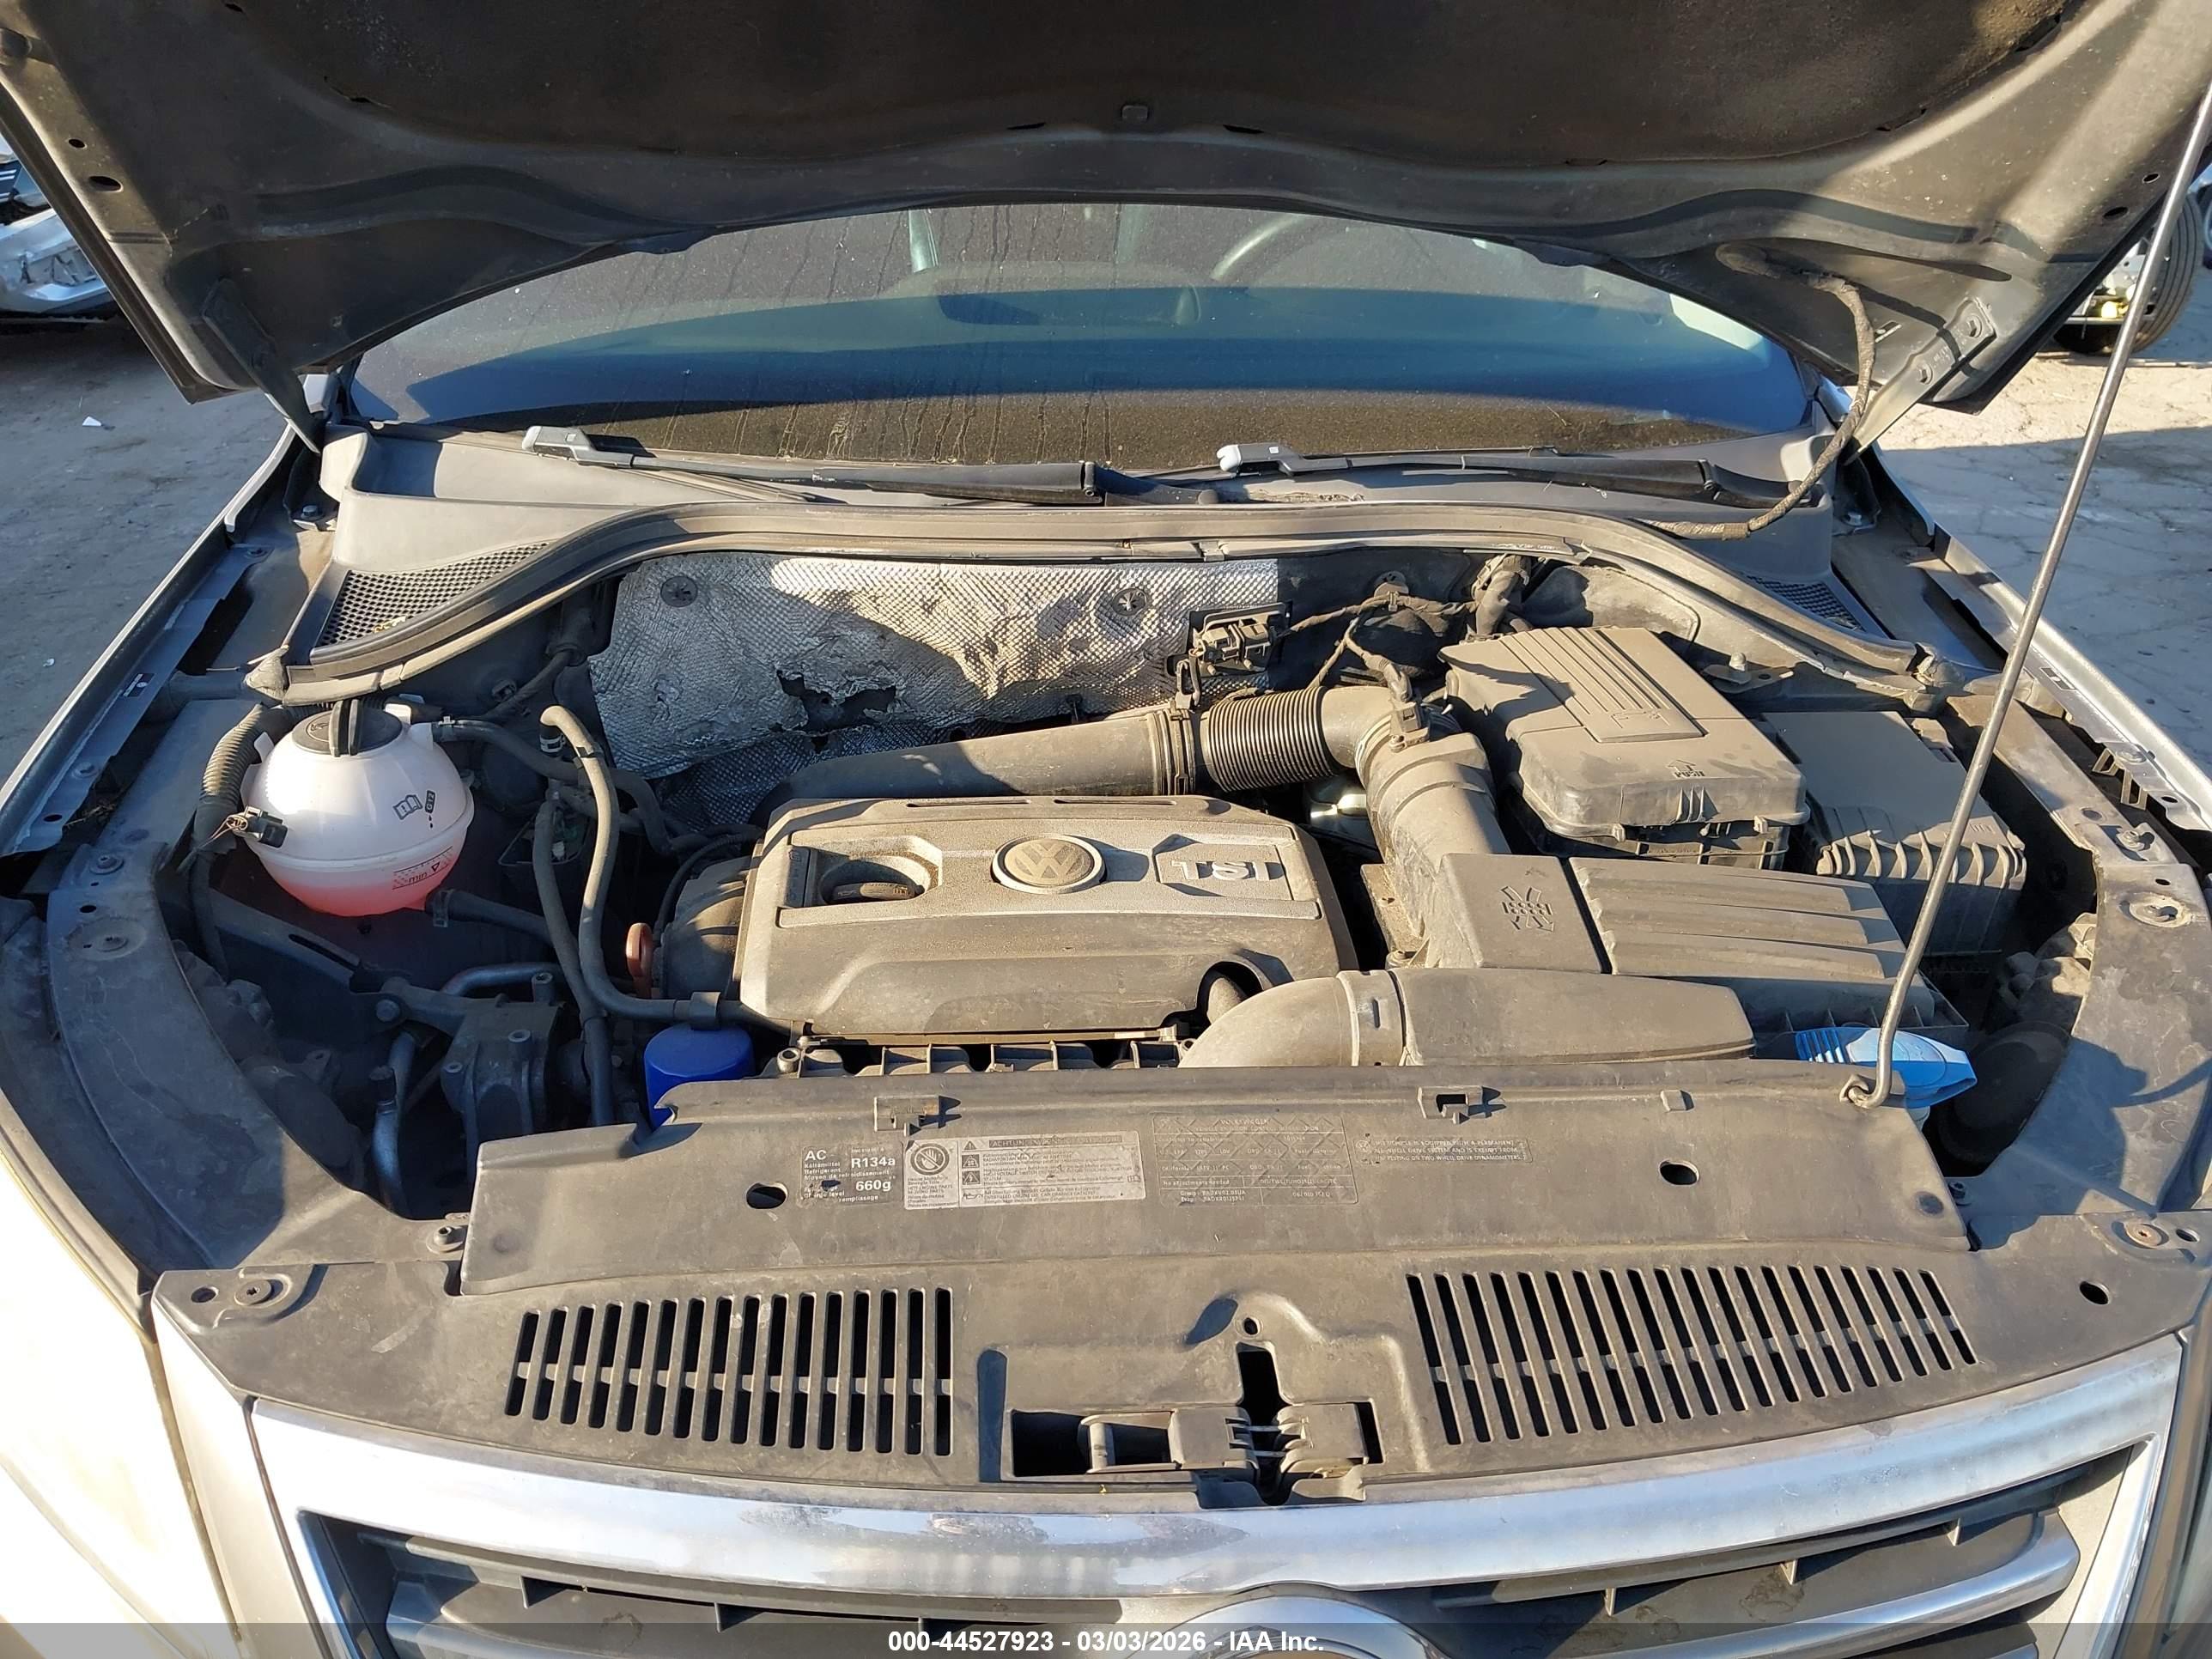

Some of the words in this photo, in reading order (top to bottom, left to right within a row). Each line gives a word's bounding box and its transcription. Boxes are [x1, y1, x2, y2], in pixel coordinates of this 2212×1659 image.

[1170, 860, 1270, 881] TSI
[409, 872, 428, 884] min
[805, 1149, 827, 1161] AC
[851, 1157, 896, 1168] R134a
[855, 1179, 892, 1192] 660g
